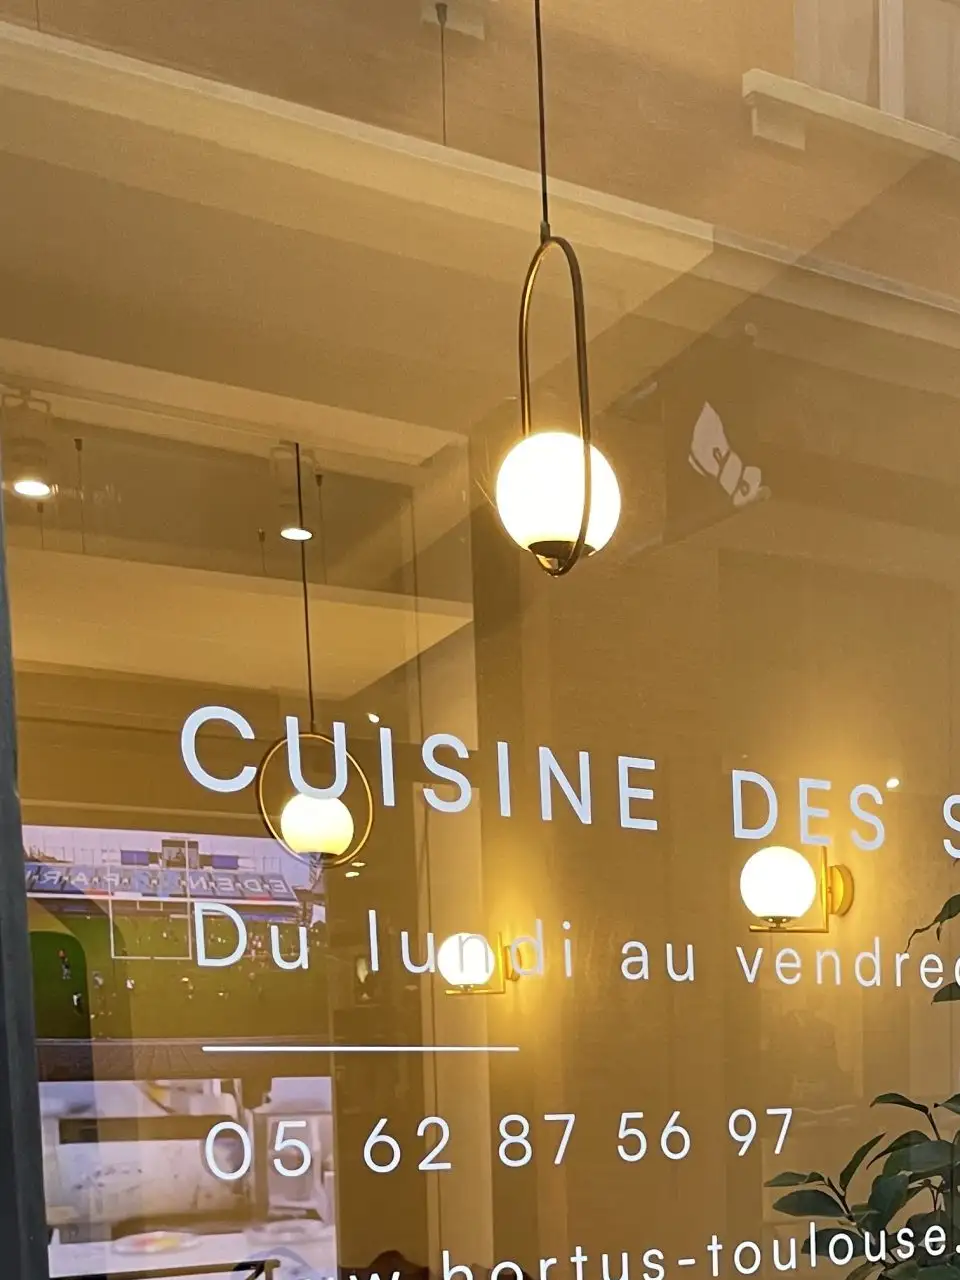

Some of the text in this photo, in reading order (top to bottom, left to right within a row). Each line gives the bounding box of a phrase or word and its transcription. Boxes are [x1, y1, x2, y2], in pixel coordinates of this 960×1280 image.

[180, 705, 659, 831] CUISINE
[731, 769, 885, 851] DES
[193, 901, 310, 970] Du
[367, 909, 573, 978] lundi
[620, 939, 695, 983] au
[204, 1107, 793, 1181] 05 62 87 56 97
